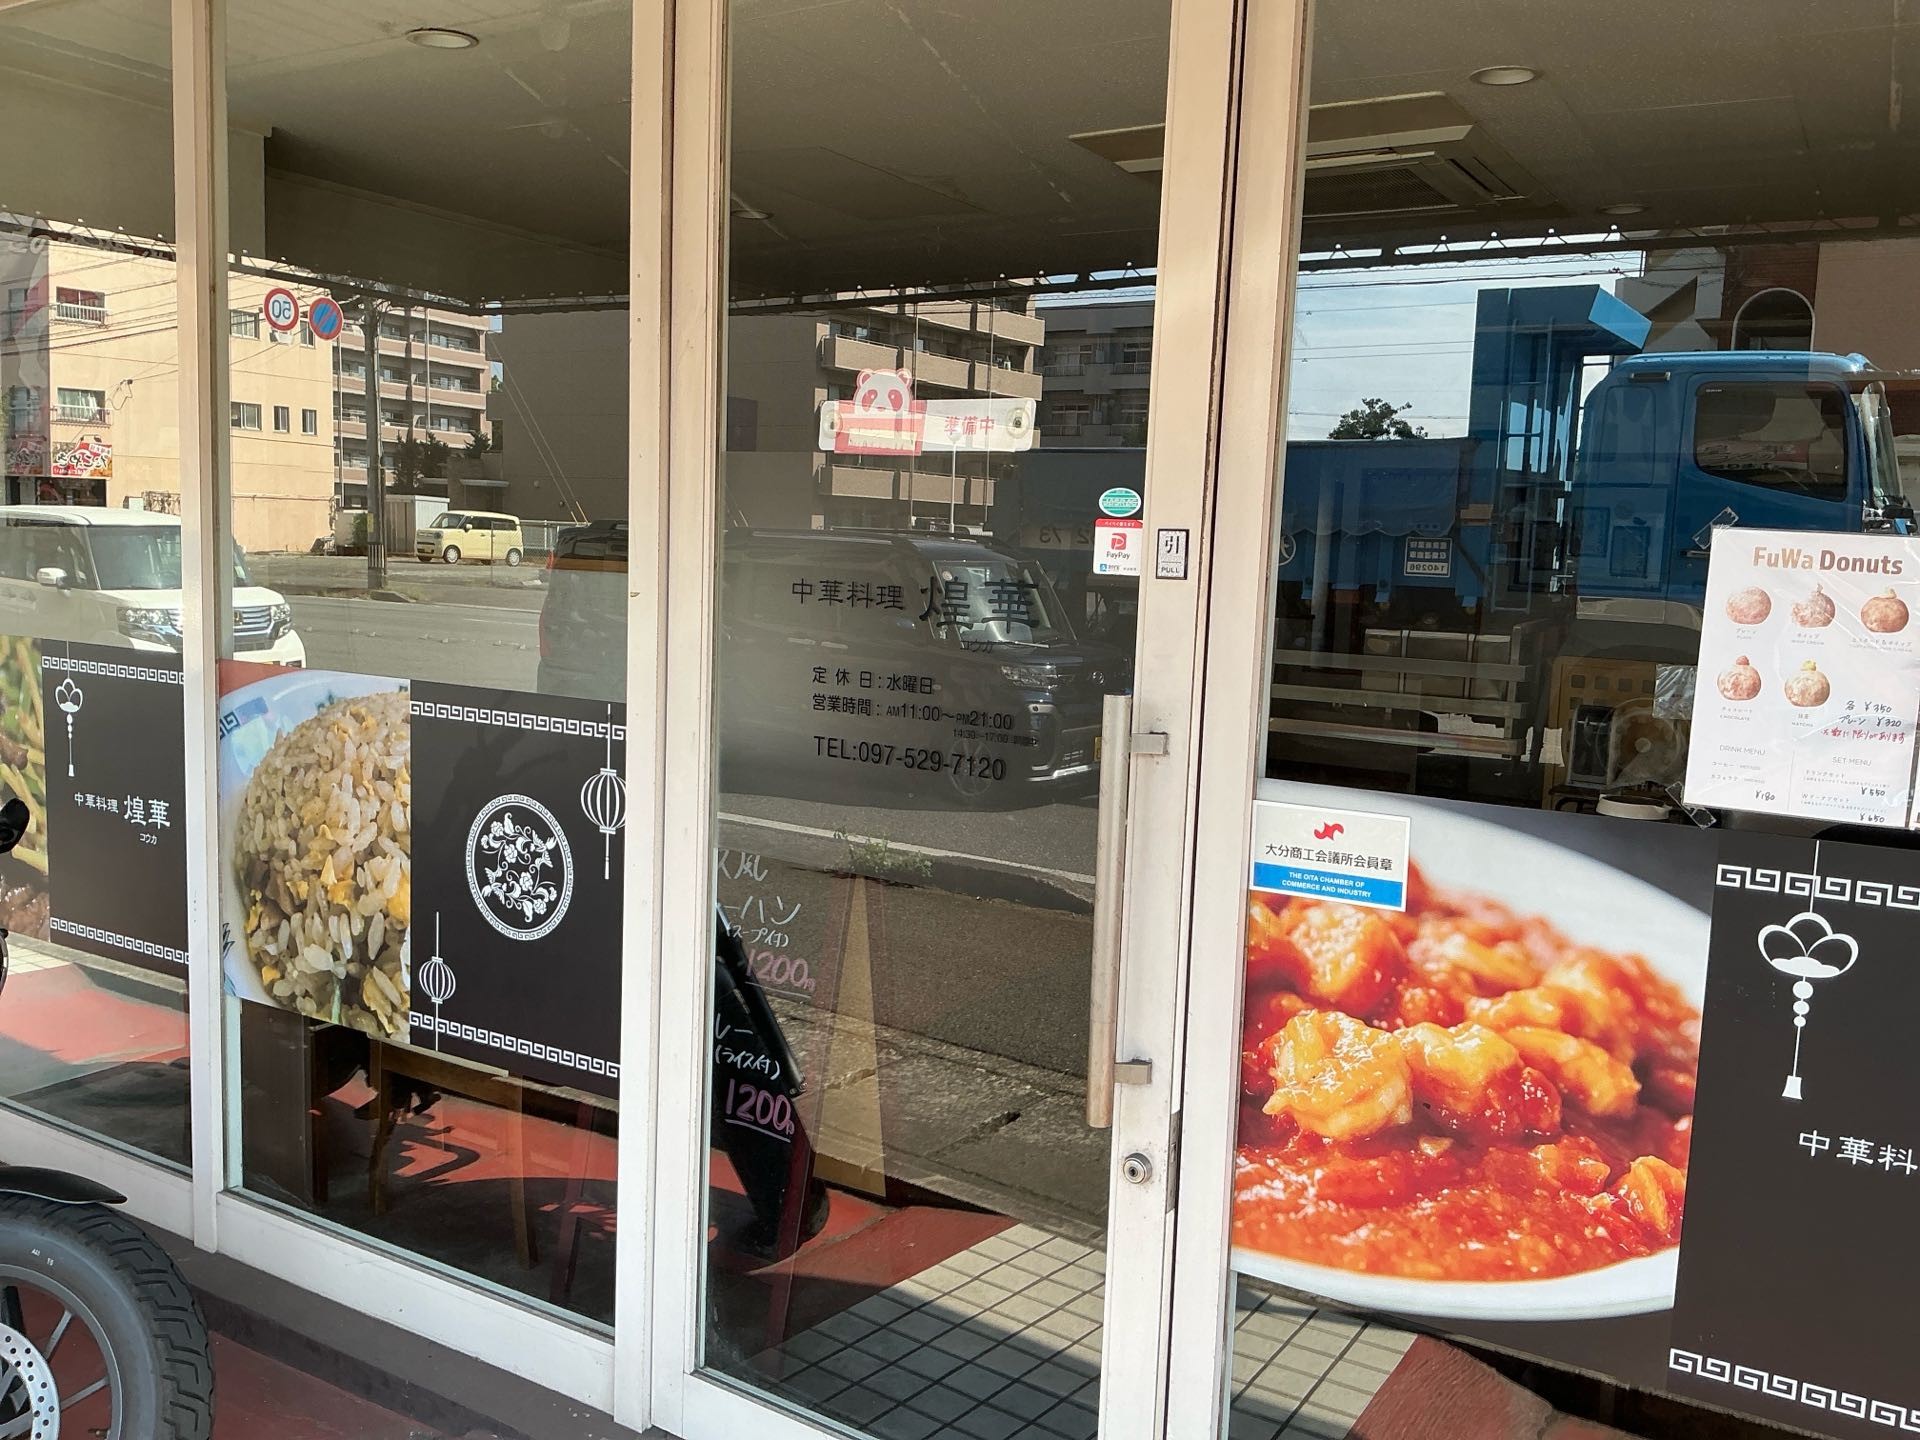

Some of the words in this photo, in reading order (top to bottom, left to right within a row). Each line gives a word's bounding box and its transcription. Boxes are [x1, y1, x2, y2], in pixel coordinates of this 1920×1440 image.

[944, 416, 995, 436] 準備中
[1165, 535, 1180, 554] 引
[1106, 551, 1130, 560] PayPay
[1753, 546, 1814, 569] FuWa
[1819, 549, 1903, 575] Donuts
[792, 578, 904, 611] 中華料理
[919, 576, 1040, 634] 煌華
[1876, 716, 1902, 728] ¥320
[813, 736, 1007, 781] TEL:097-529-7120
[1743, 747, 1766, 756] MENU
[1832, 756, 1847, 765] SET
[1849, 758, 1872, 767] MENU
[1755, 790, 1776, 801] ¥180
[1861, 786, 1886, 797] ¥550
[74, 792, 119, 814] 中華料理
[123, 794, 171, 830] 煌華
[1859, 812, 1885, 824] ¥650
[139, 832, 158, 846] コウカ
[1265, 843, 1393, 871] 大分商工会議所会員章
[1289, 871, 1302, 880] THE
[1303, 873, 1319, 882] OITA
[1320, 876, 1354, 887] CHAMBER
[1282, 879, 1320, 891] COMMERCE
[1321, 884, 1336, 893] AND
[1337, 887, 1372, 898] INDUSTRY
[1798, 1129, 1918, 1175] 中華料
